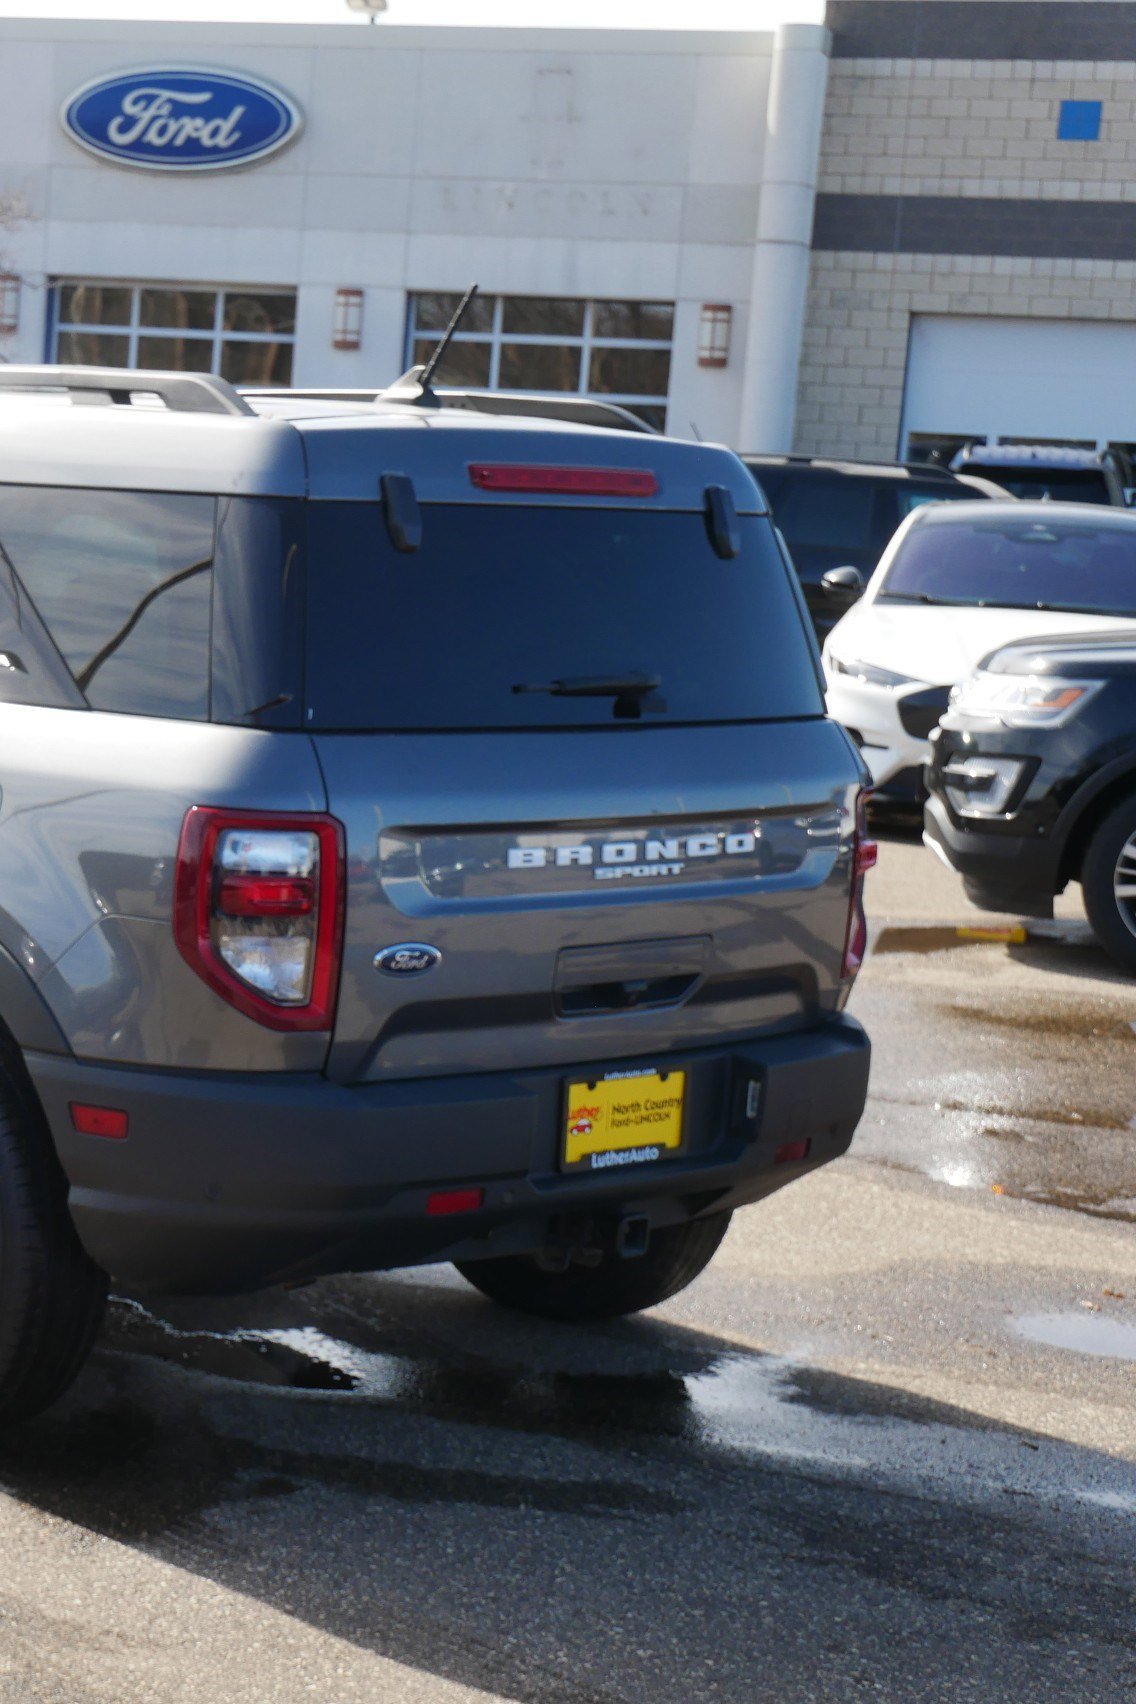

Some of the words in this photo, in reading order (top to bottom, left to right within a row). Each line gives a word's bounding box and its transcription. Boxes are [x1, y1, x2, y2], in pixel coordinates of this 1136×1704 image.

[107, 87, 247, 149] Ford
[507, 832, 756, 869] BRONCO
[593, 862, 685, 880] SPORT
[390, 950, 429, 970] Ford
[612, 1101, 641, 1115] North
[644, 1097, 683, 1112] Country
[591, 1146, 660, 1168] LutherAuto
